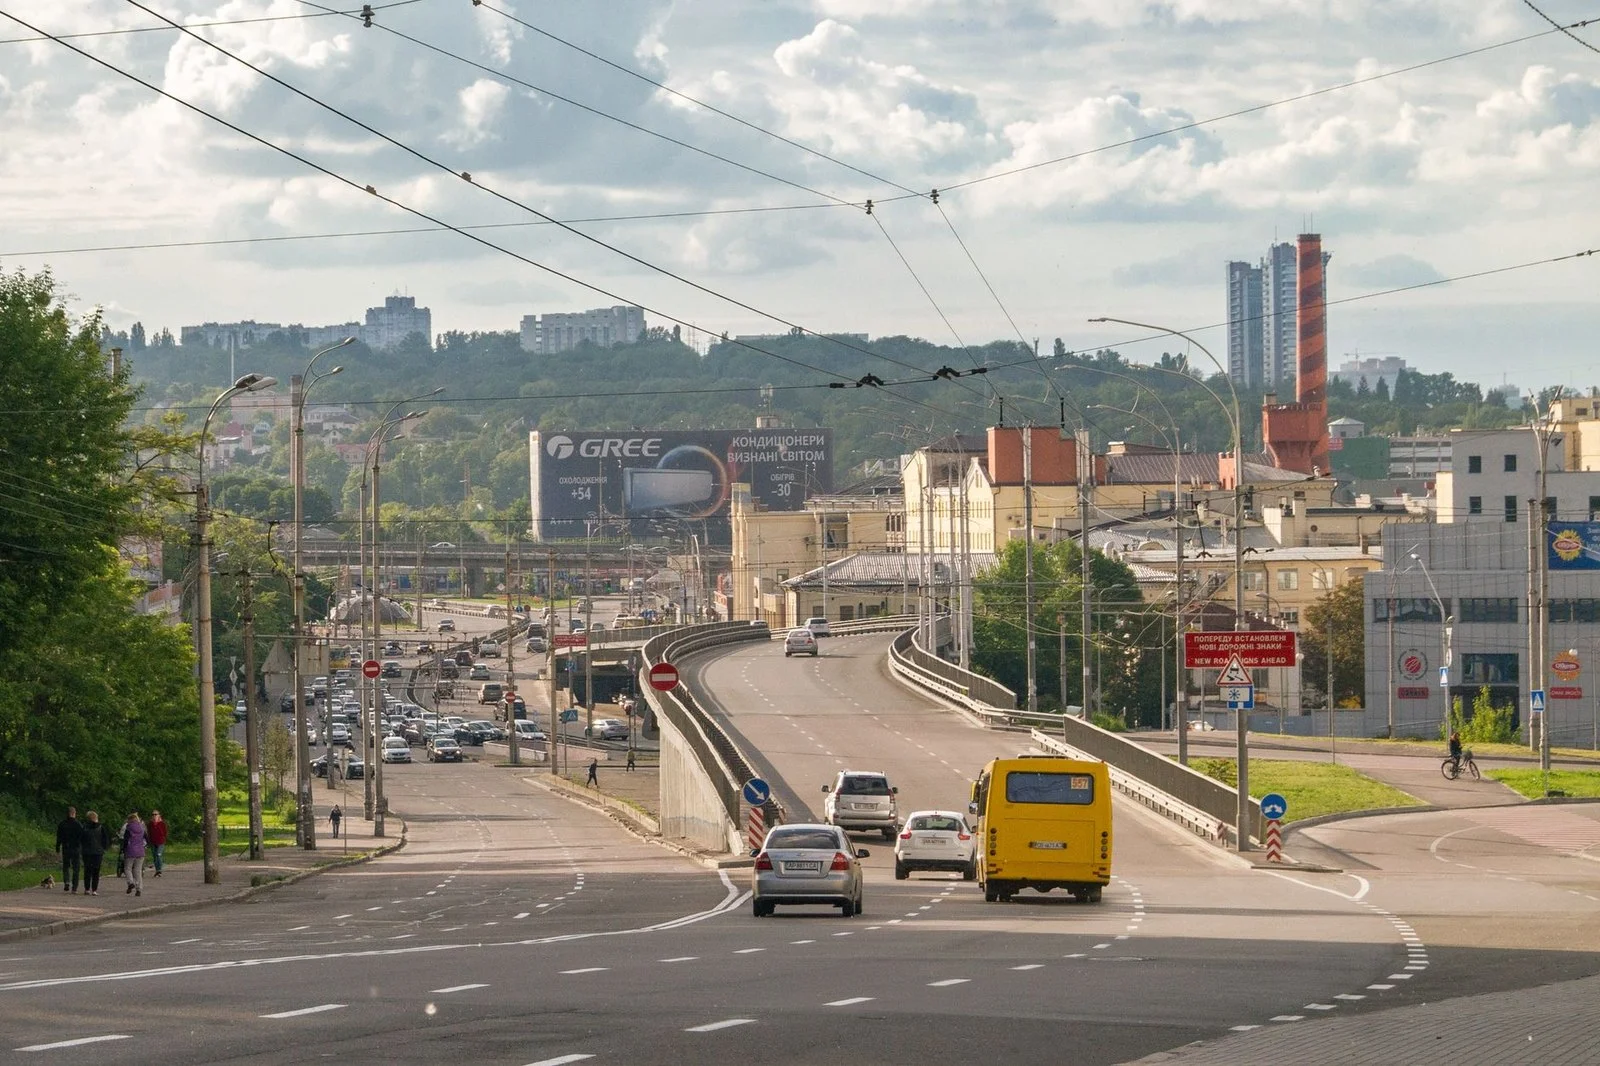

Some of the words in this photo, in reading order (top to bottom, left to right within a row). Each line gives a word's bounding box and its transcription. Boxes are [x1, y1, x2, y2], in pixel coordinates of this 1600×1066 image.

[579, 438, 662, 458] GREE
[732, 435, 825, 449] КОНДИЦІОНЕРИ
[727, 452, 778, 463] ВИЗНАНІ
[780, 450, 825, 462] СВІТОМ
[559, 476, 608, 485] ОХОЛОДЖЕННЯ
[571, 487, 592, 500] +54
[1218, 643, 1255, 651] ДОРОЖНІ
